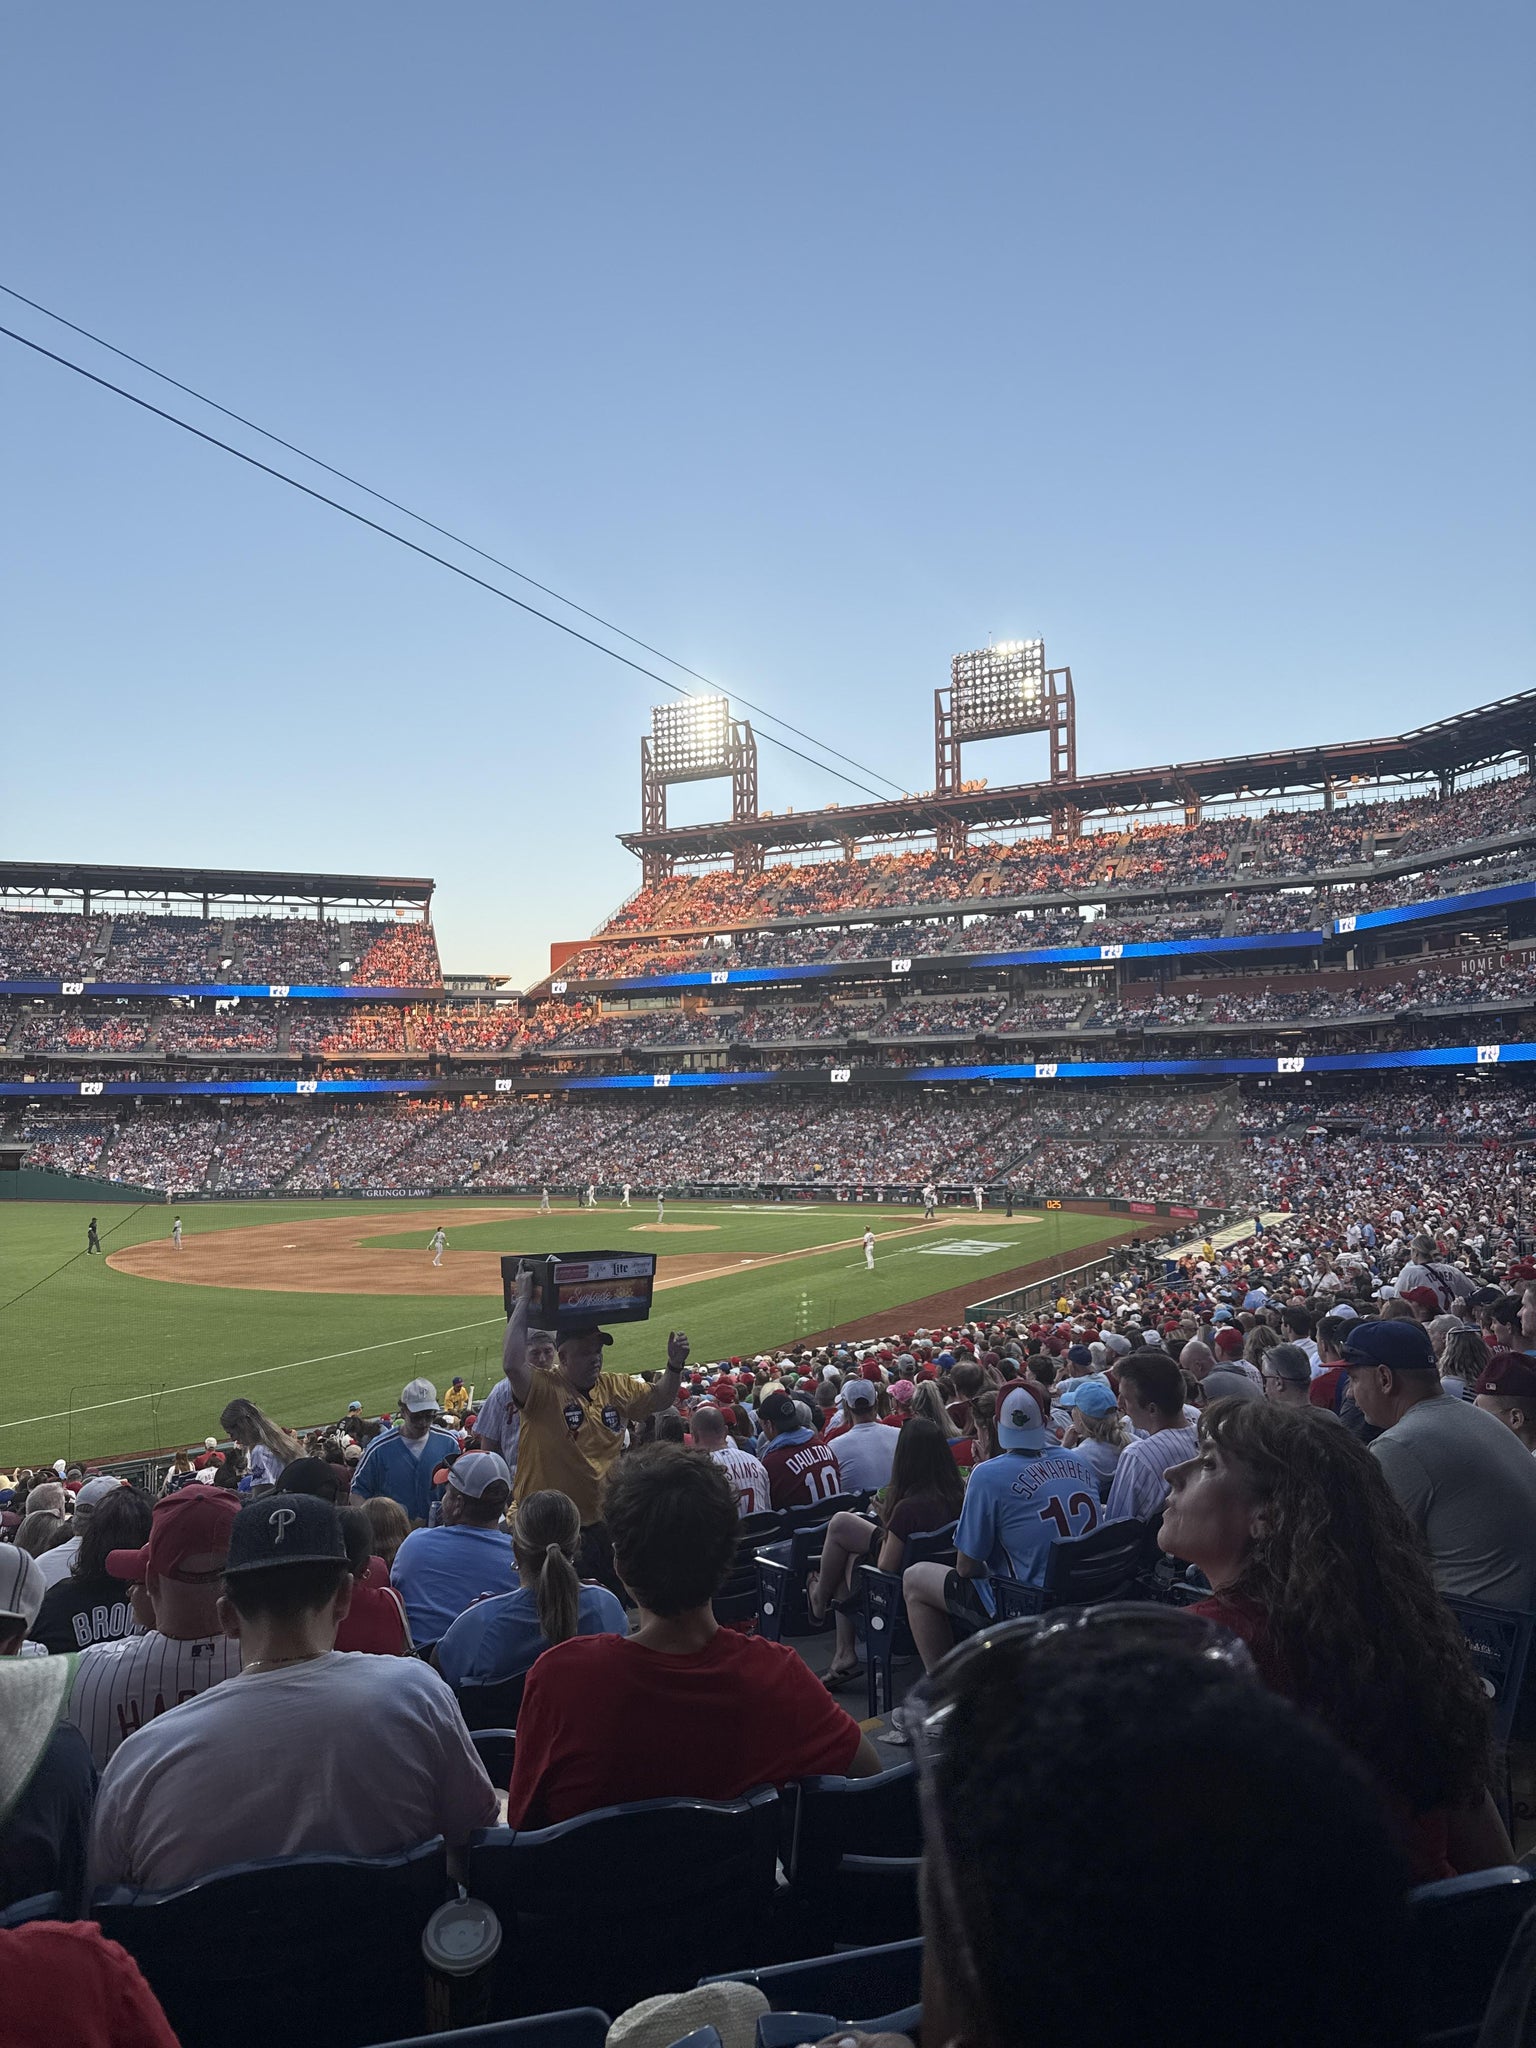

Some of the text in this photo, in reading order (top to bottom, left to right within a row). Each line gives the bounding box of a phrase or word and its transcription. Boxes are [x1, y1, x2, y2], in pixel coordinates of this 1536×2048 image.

[1461, 956, 1493, 973] HOME
[1499, 953, 1514, 969] O
[366, 1189, 426, 1197] GRUNGO LAW
[612, 1262, 629, 1277] Lite
[785, 1444, 834, 1475] DAULTON
[804, 1464, 841, 1504] 10
[1011, 1458, 1092, 1500] SCHWARBER
[268, 1508, 297, 1545] P
[1037, 1491, 1099, 1537] 12
